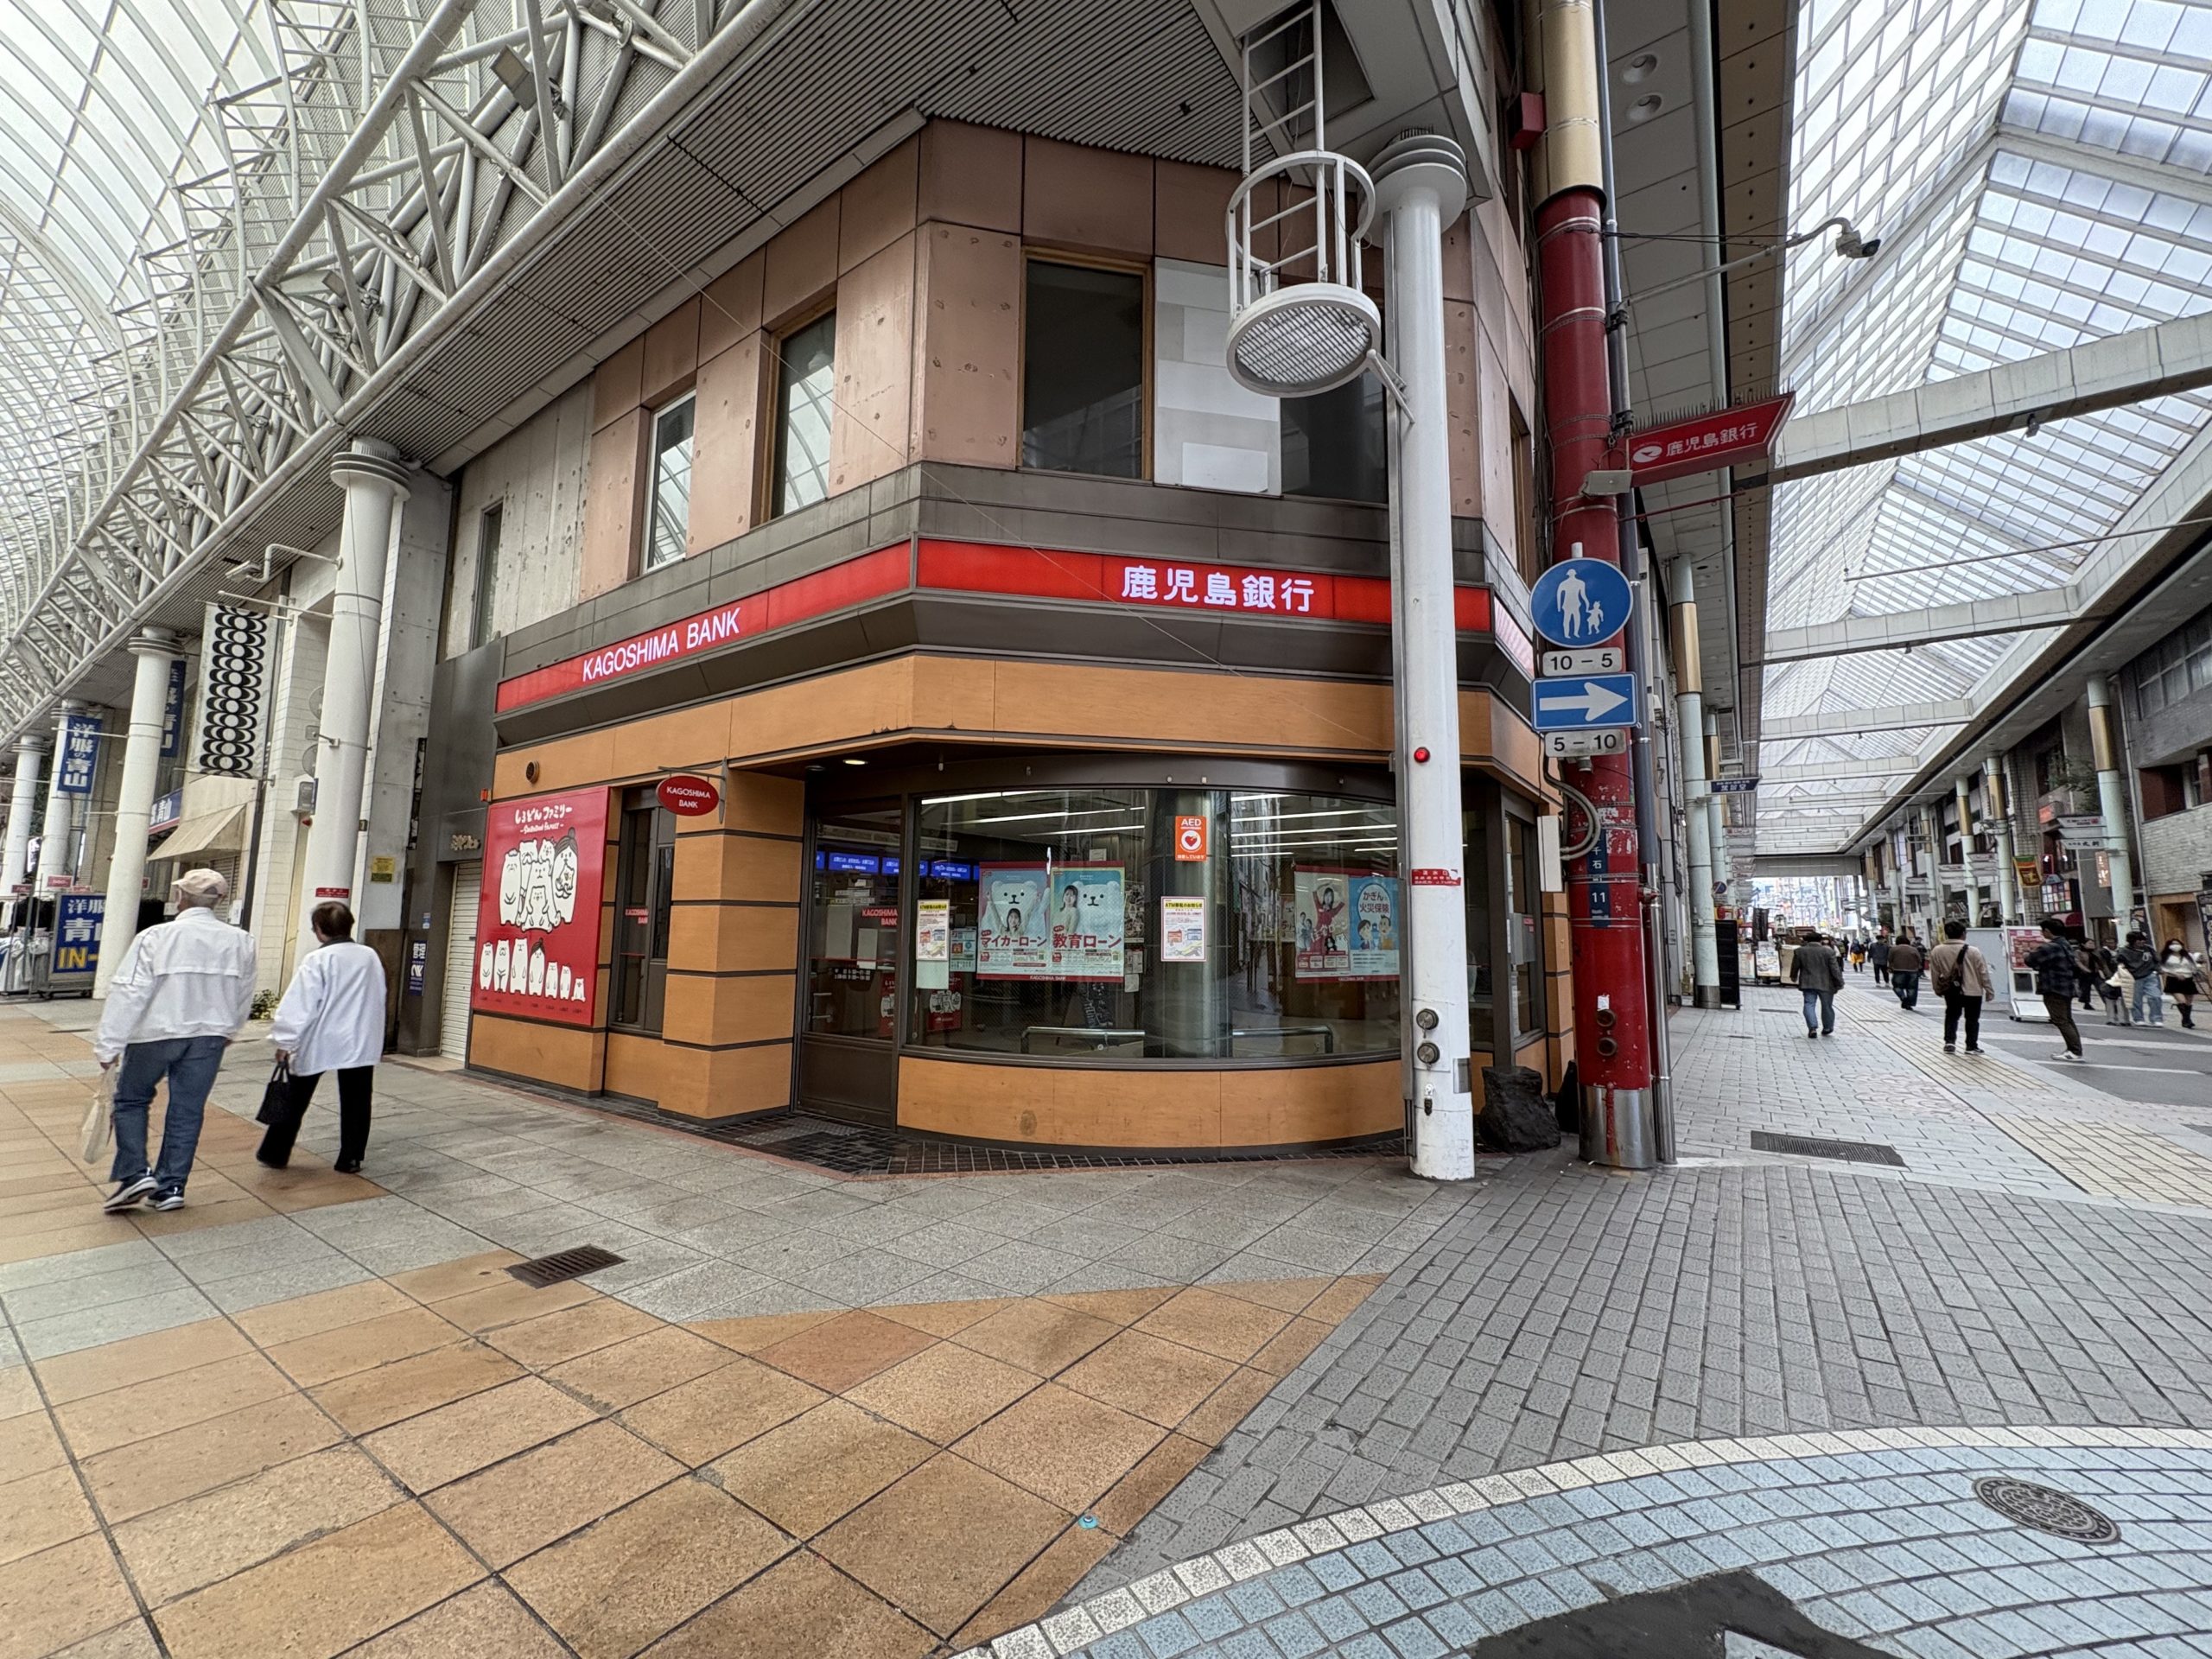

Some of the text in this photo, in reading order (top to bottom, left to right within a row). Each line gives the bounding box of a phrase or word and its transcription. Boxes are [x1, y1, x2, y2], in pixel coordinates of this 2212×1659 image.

[1666, 422, 1758, 457] 鹿児島銀行
[1122, 565, 1314, 612] 鹿児島銀行
[582, 607, 741, 682] KAGOSHIMA BANK
[63, 723, 95, 787] 洋服の青山
[666, 786, 711, 798] KAGOSHIMA
[678, 799, 698, 809] BANK
[1592, 892, 1605, 903] 11
[861, 909, 898, 918] KAGOSHIMA
[1360, 902, 1389, 913] 火災保険
[981, 936, 1047, 948] マイカーローン
[1052, 933, 1122, 949] 教育ローン
